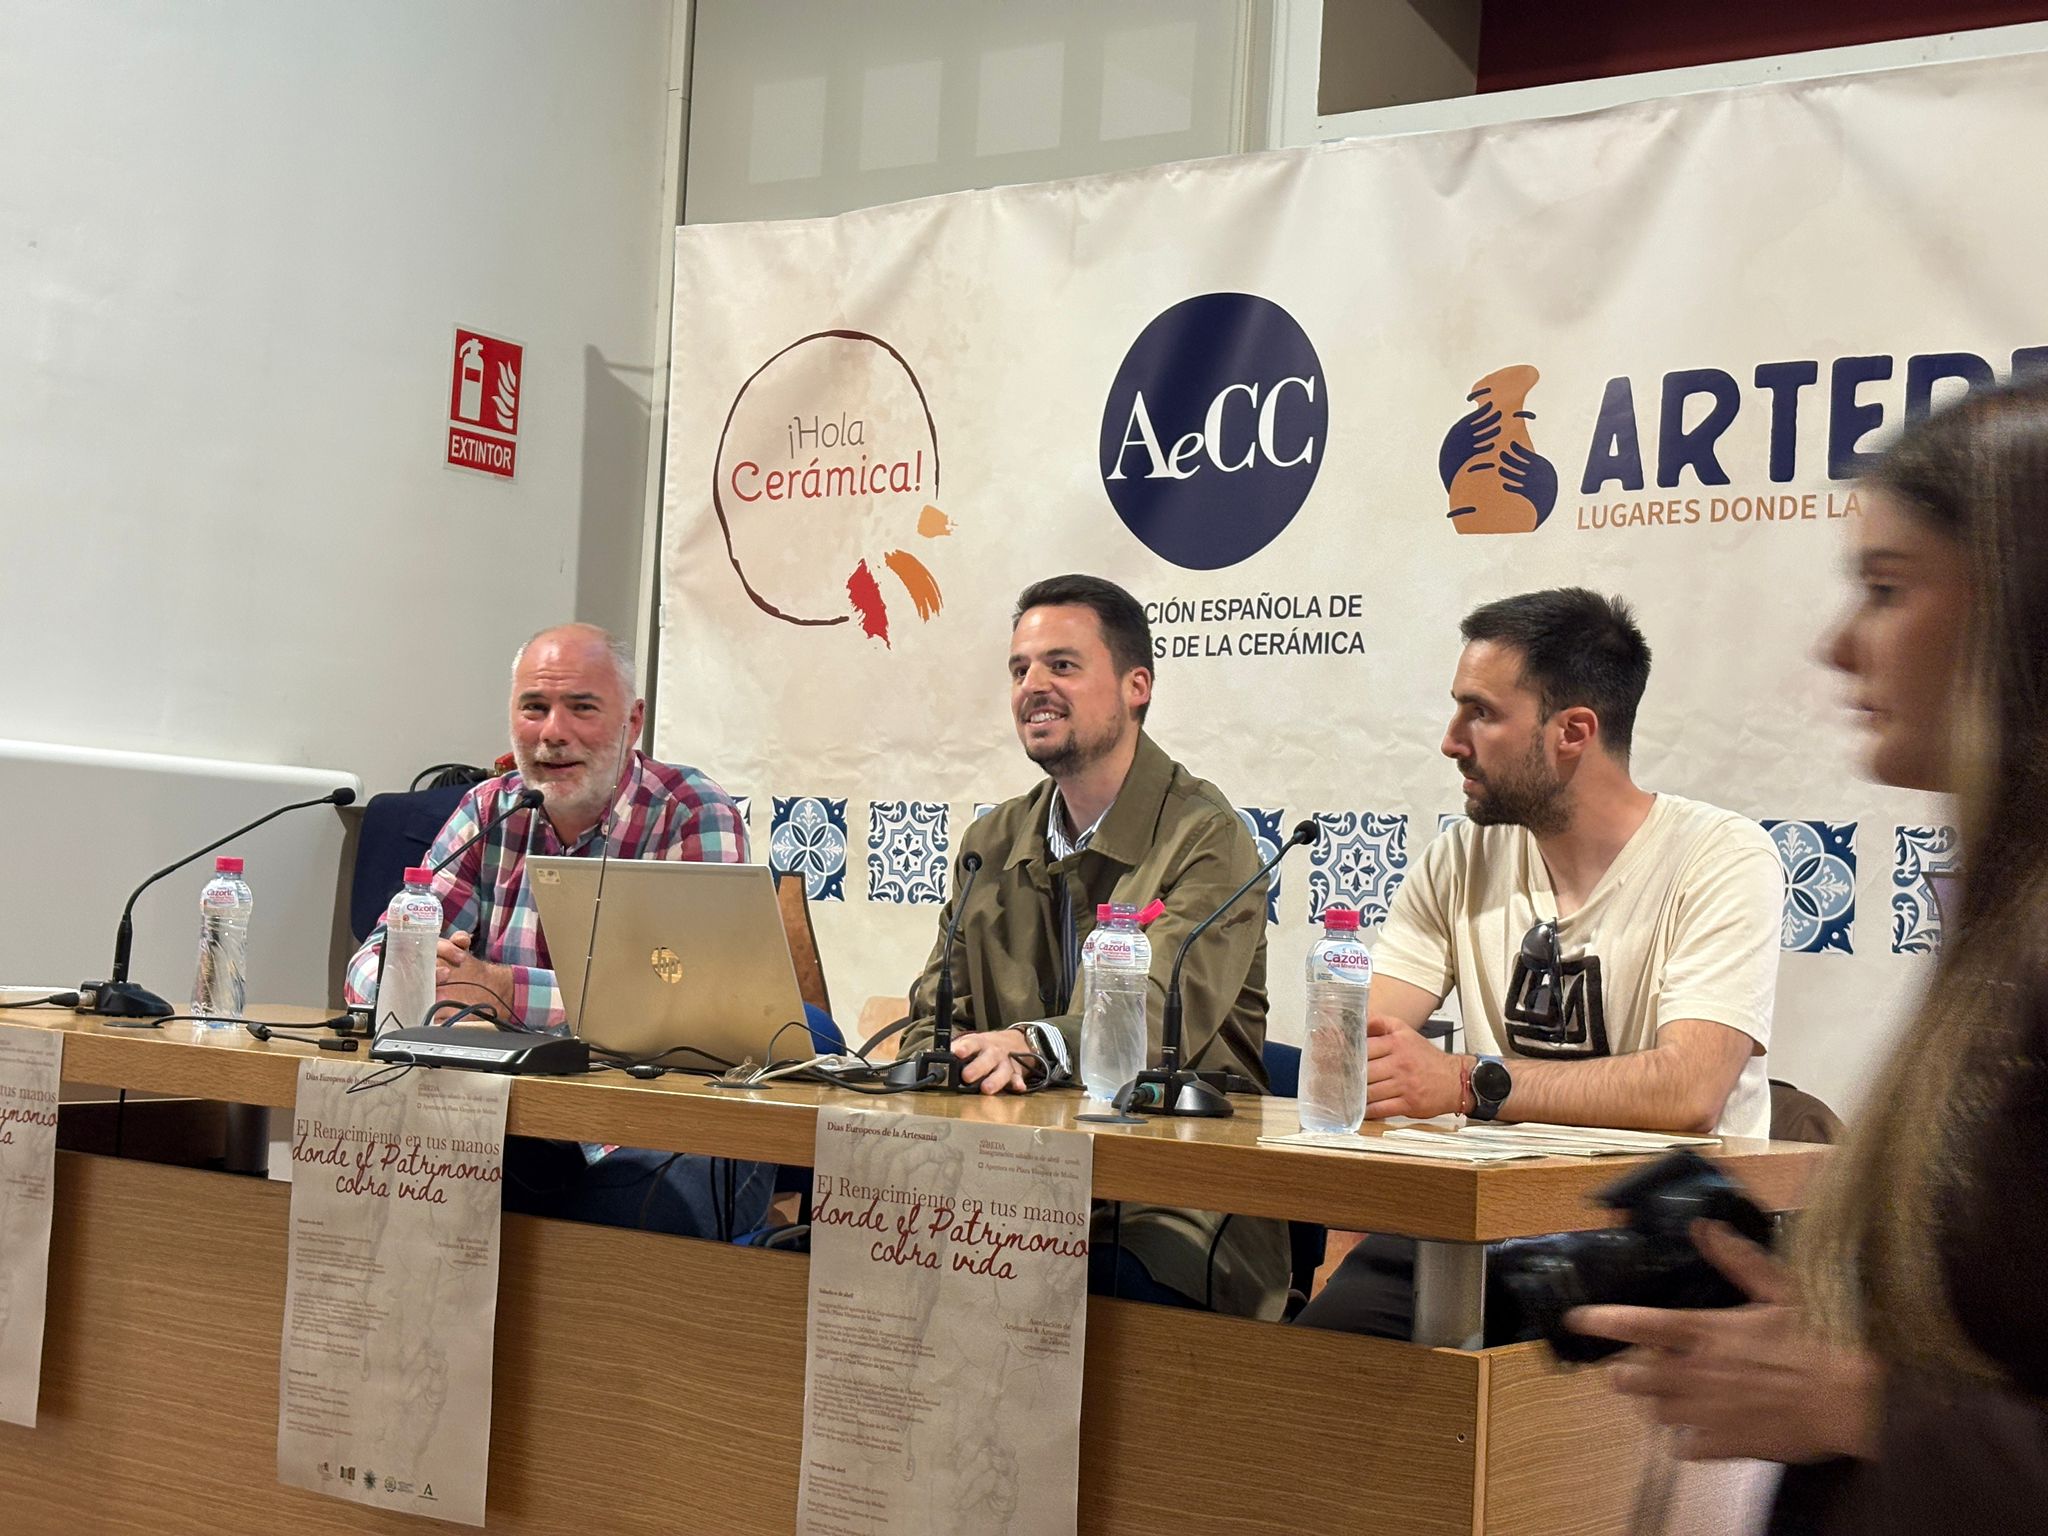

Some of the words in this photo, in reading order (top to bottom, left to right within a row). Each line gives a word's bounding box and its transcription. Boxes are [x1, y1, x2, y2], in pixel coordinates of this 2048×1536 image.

[787, 412, 866, 460] ¡Hola
[1107, 375, 1315, 480] AeCC
[1580, 345, 2048, 495] ARTE
[451, 434, 512, 470] EXTINTOR
[731, 449, 923, 501] Cerámica!
[1576, 498, 1701, 530] LUGARES
[1709, 494, 1817, 523] DONDE
[1200, 592, 1322, 622] ESPAÑOLA
[1329, 594, 1363, 618] DE
[1172, 635, 1200, 658] DE
[1205, 633, 1233, 657] LA
[1238, 627, 1366, 656] CERÁMICA
[1099, 941, 1131, 952] Cazorla
[1323, 950, 1369, 966] Cazorla
[19, 1088, 57, 1104] manos
[297, 1119, 309, 1136] El
[313, 1120, 402, 1145] Renacimiento
[405, 1134, 421, 1147] en
[426, 1136, 447, 1150] tus
[451, 1139, 500, 1155] manos
[881, 1128, 891, 1136] de
[892, 1128, 900, 1137] la
[292, 1133, 350, 1167] donde
[380, 1143, 502, 1183] Patrimonio
[336, 1163, 390, 1197] cobra
[398, 1175, 447, 1204] vida
[816, 1174, 833, 1195] El
[840, 1176, 956, 1210] Renacimiento
[962, 1198, 983, 1214] en
[991, 1199, 1017, 1217] tus
[1023, 1205, 1085, 1226] manos
[811, 1190, 888, 1232] donde
[897, 1202, 920, 1235] el
[928, 1207, 1088, 1258] Patrimonio
[871, 1231, 942, 1270] cobra
[953, 1244, 1018, 1280] vida
